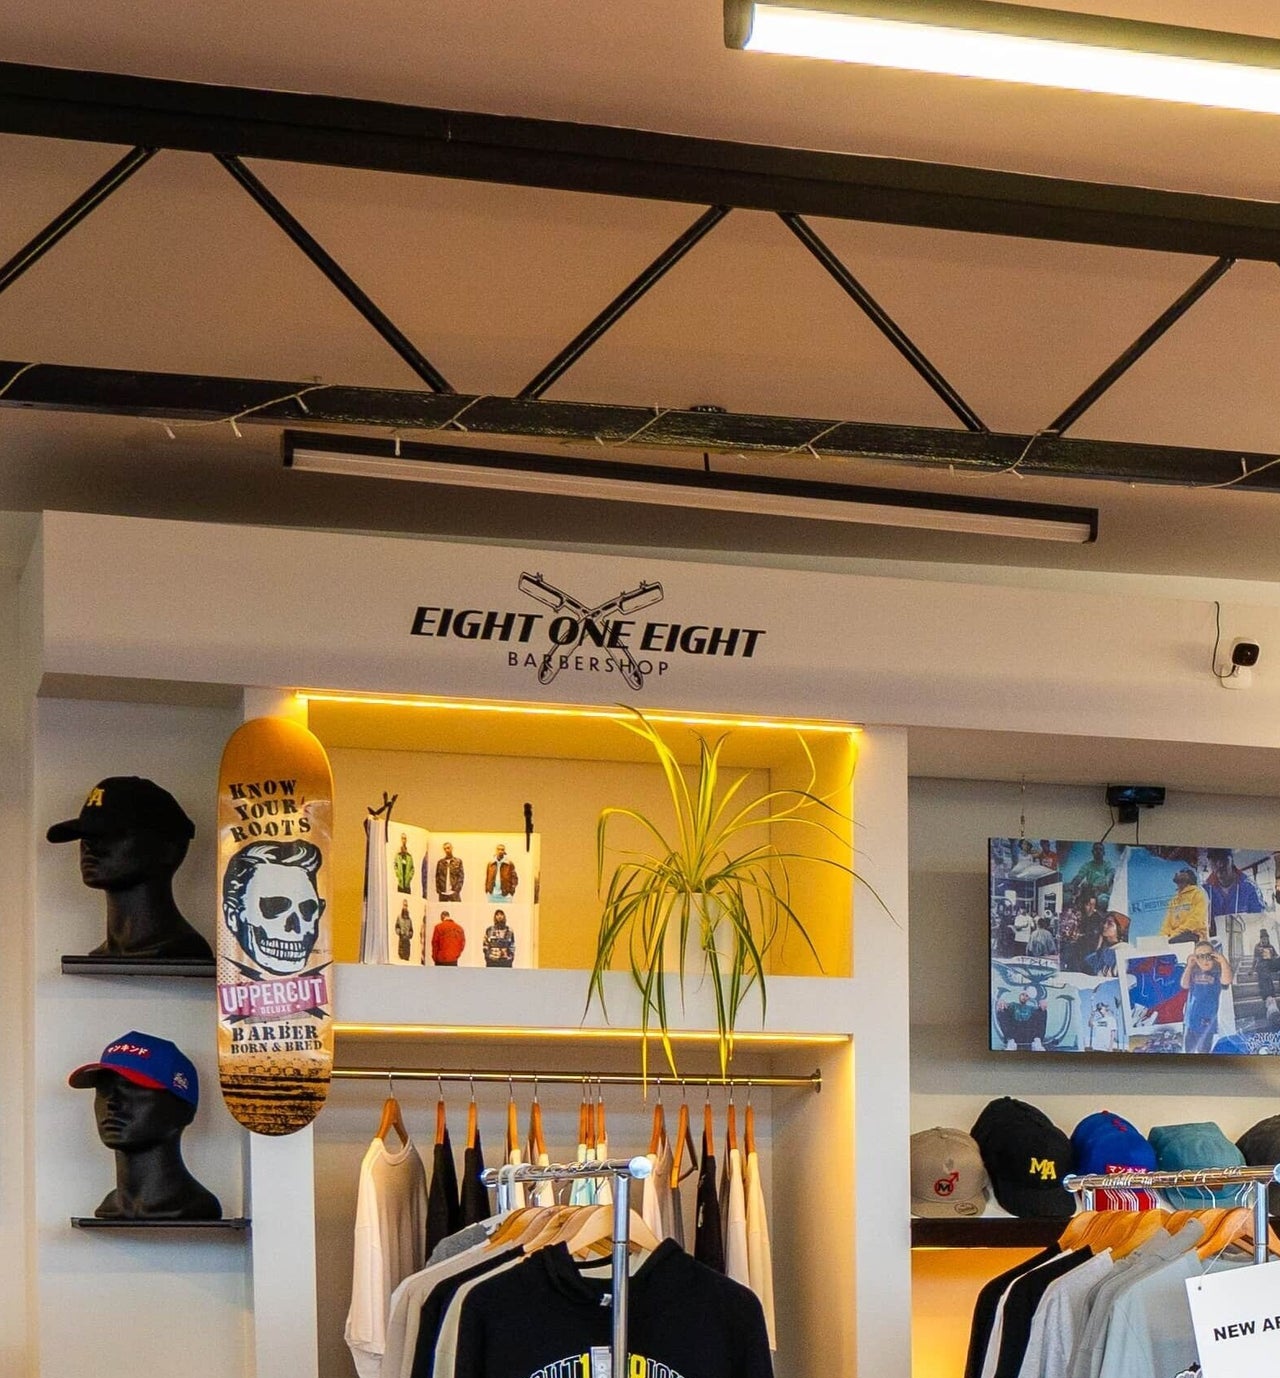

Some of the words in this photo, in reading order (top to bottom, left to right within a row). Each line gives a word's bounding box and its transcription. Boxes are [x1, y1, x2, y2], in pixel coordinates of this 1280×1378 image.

[410, 606, 543, 642] EIGHT
[548, 616, 635, 649] ONE
[639, 622, 767, 658] EIGHT
[508, 651, 669, 676] BARBERSHOP
[229, 779, 297, 800] KNOW
[234, 799, 299, 820] YOUR
[230, 817, 311, 842] ROOTS
[222, 979, 322, 1012] UPPERCUT
[261, 1004, 292, 1014] DELUXE
[232, 1025, 319, 1042] BARBER
[231, 1042, 267, 1054] BORN
[272, 1041, 280, 1052] &
[285, 1040, 323, 1052] BRED
[1213, 1321, 1256, 1342] NEW
